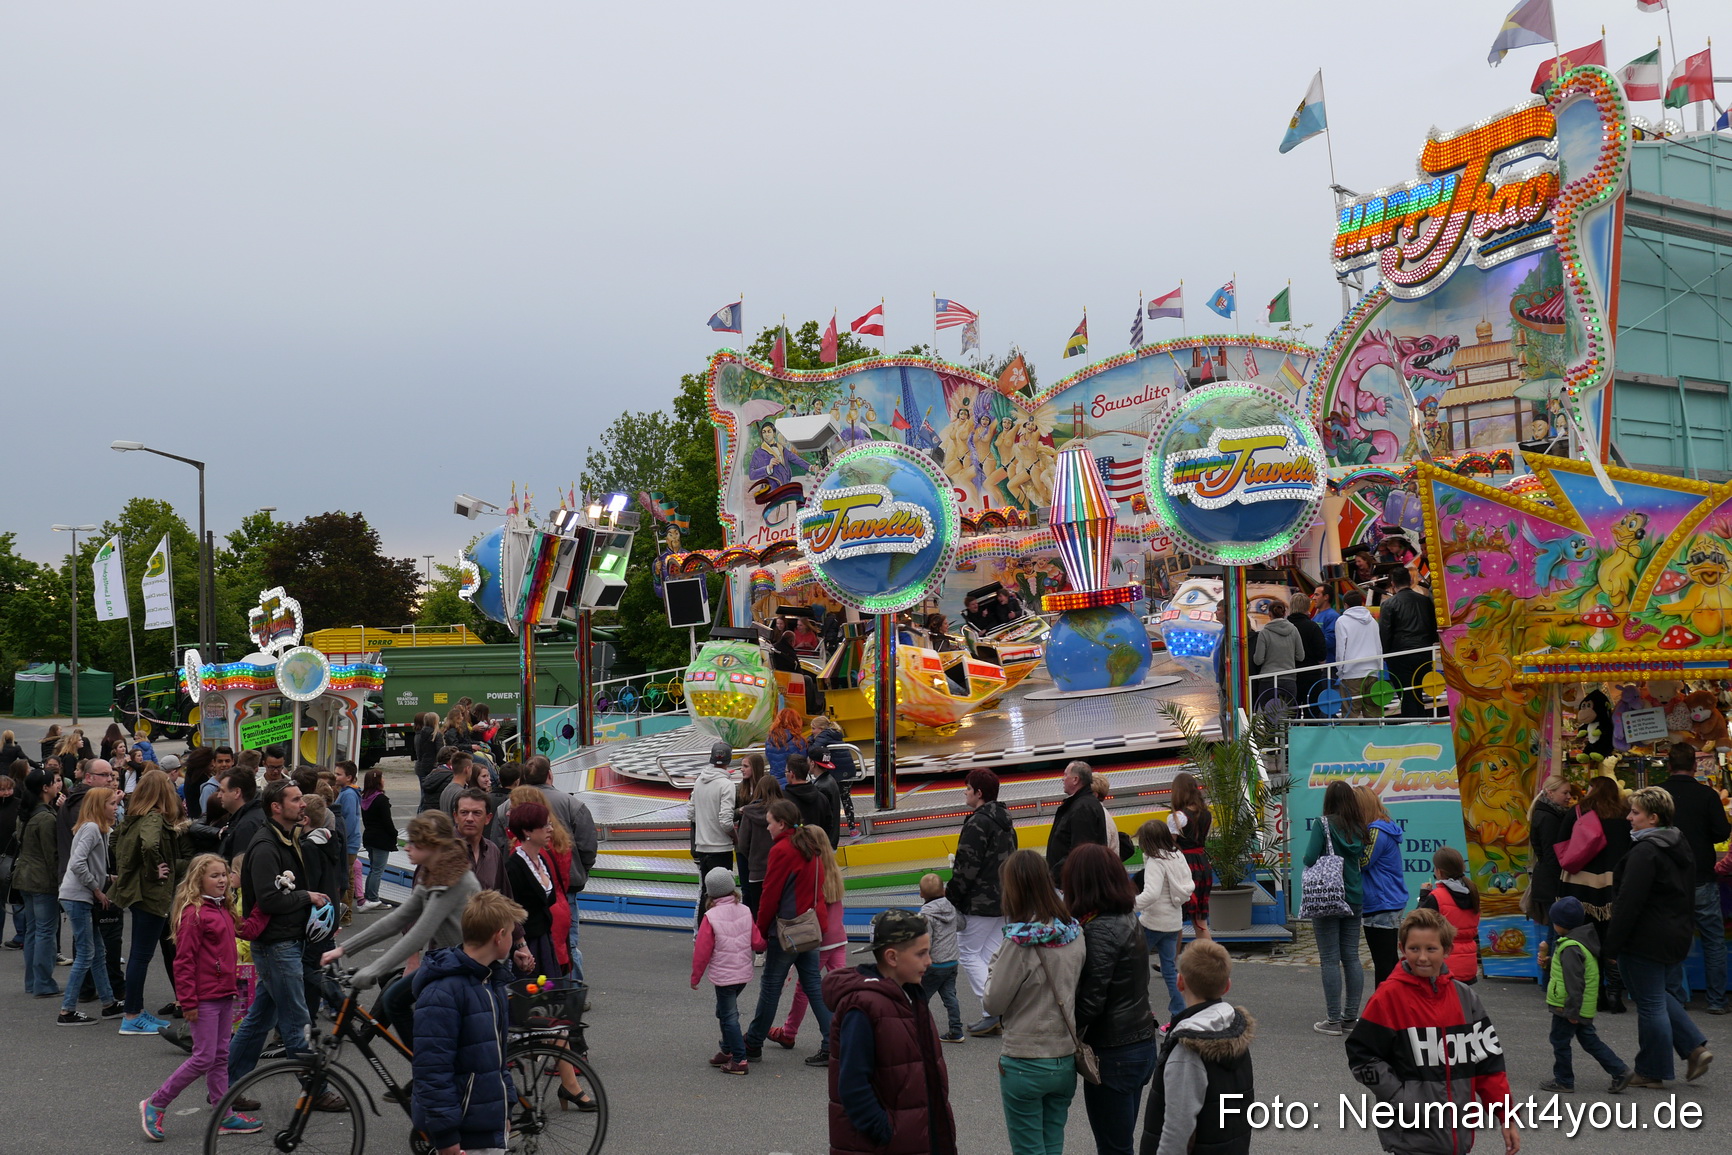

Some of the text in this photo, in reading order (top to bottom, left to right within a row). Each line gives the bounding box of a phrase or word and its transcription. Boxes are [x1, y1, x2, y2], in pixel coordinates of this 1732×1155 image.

[1334, 174, 1457, 260] HAPPY
[1091, 384, 1171, 419] Sausalito
[1173, 452, 1236, 488] HAPPY
[748, 523, 797, 545] Mont
[810, 493, 926, 554] Traveller
[1149, 536, 1173, 552] Ca
[1536, 659, 1684, 674] VIEL VERGNÜGEN
[486, 692, 521, 700] POWER-T
[270, 733, 288, 743] Preise
